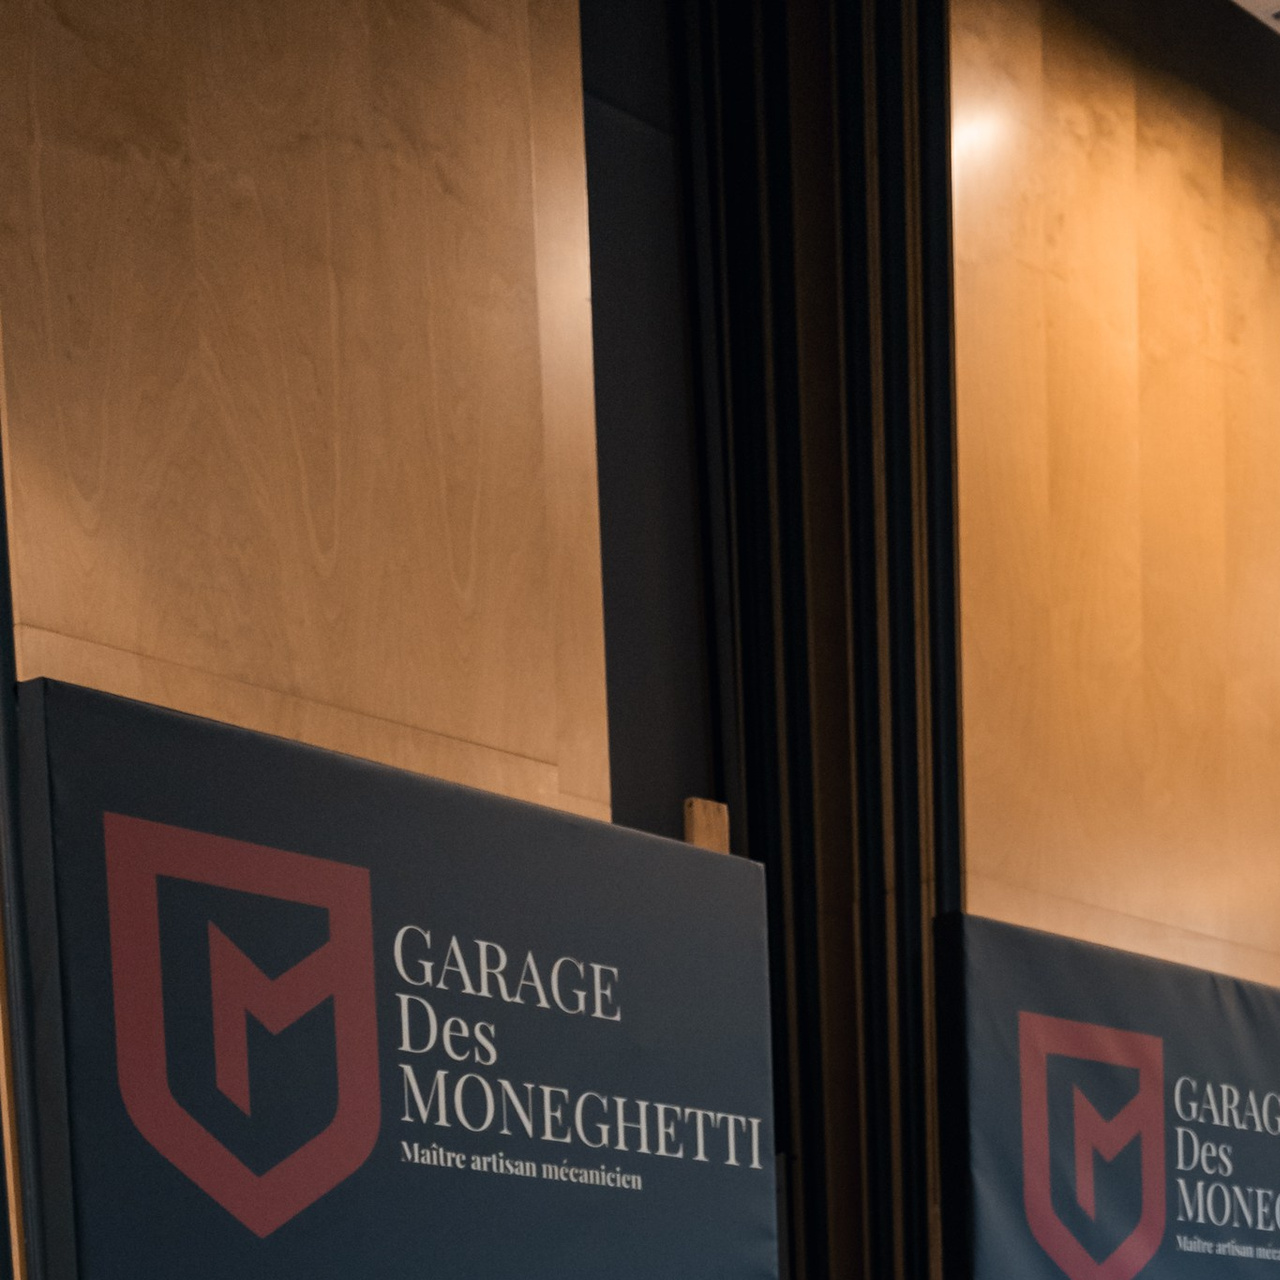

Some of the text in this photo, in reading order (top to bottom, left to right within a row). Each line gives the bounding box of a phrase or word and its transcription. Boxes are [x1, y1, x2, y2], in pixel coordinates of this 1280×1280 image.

[393, 925, 622, 1022] GARAGE
[395, 992, 498, 1066] Des
[398, 1063, 763, 1170] MONEGHETTI
[401, 1141, 643, 1190] Maître artisan mécanicien
[1175, 1126, 1233, 1177] Des
[1215, 1239, 1254, 1259] artisan
